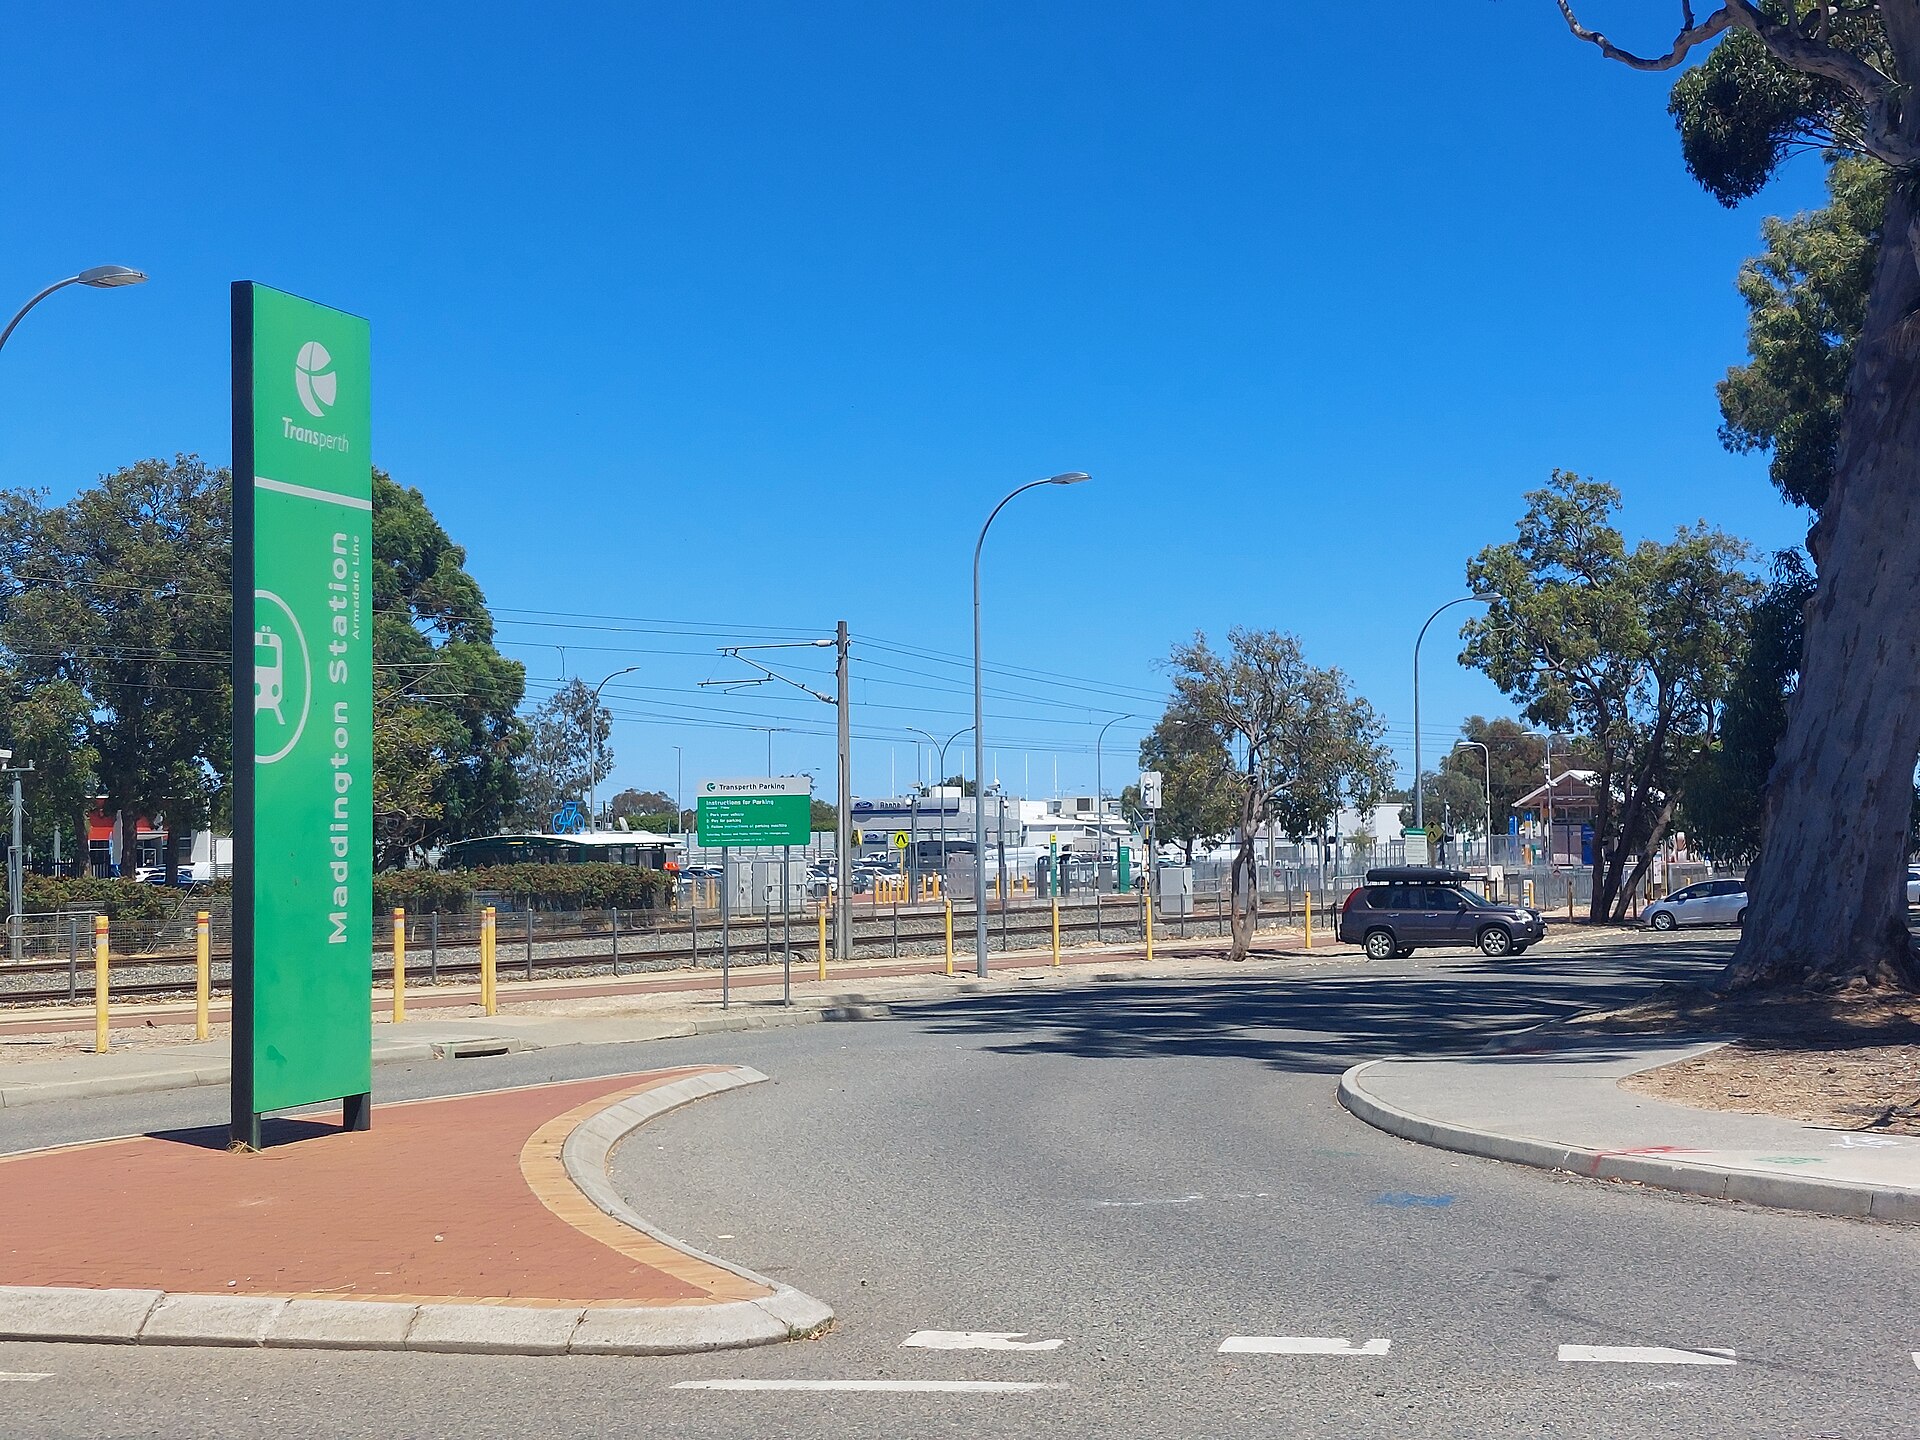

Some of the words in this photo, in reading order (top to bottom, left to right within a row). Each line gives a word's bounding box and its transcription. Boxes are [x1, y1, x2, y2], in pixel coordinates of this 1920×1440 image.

[282, 416, 349, 453] Transperth
[351, 535, 360, 566] Line
[328, 533, 348, 684] Station
[351, 570, 360, 640] Armadale
[759, 783, 785, 791] Parking
[328, 702, 353, 944] Maddington
